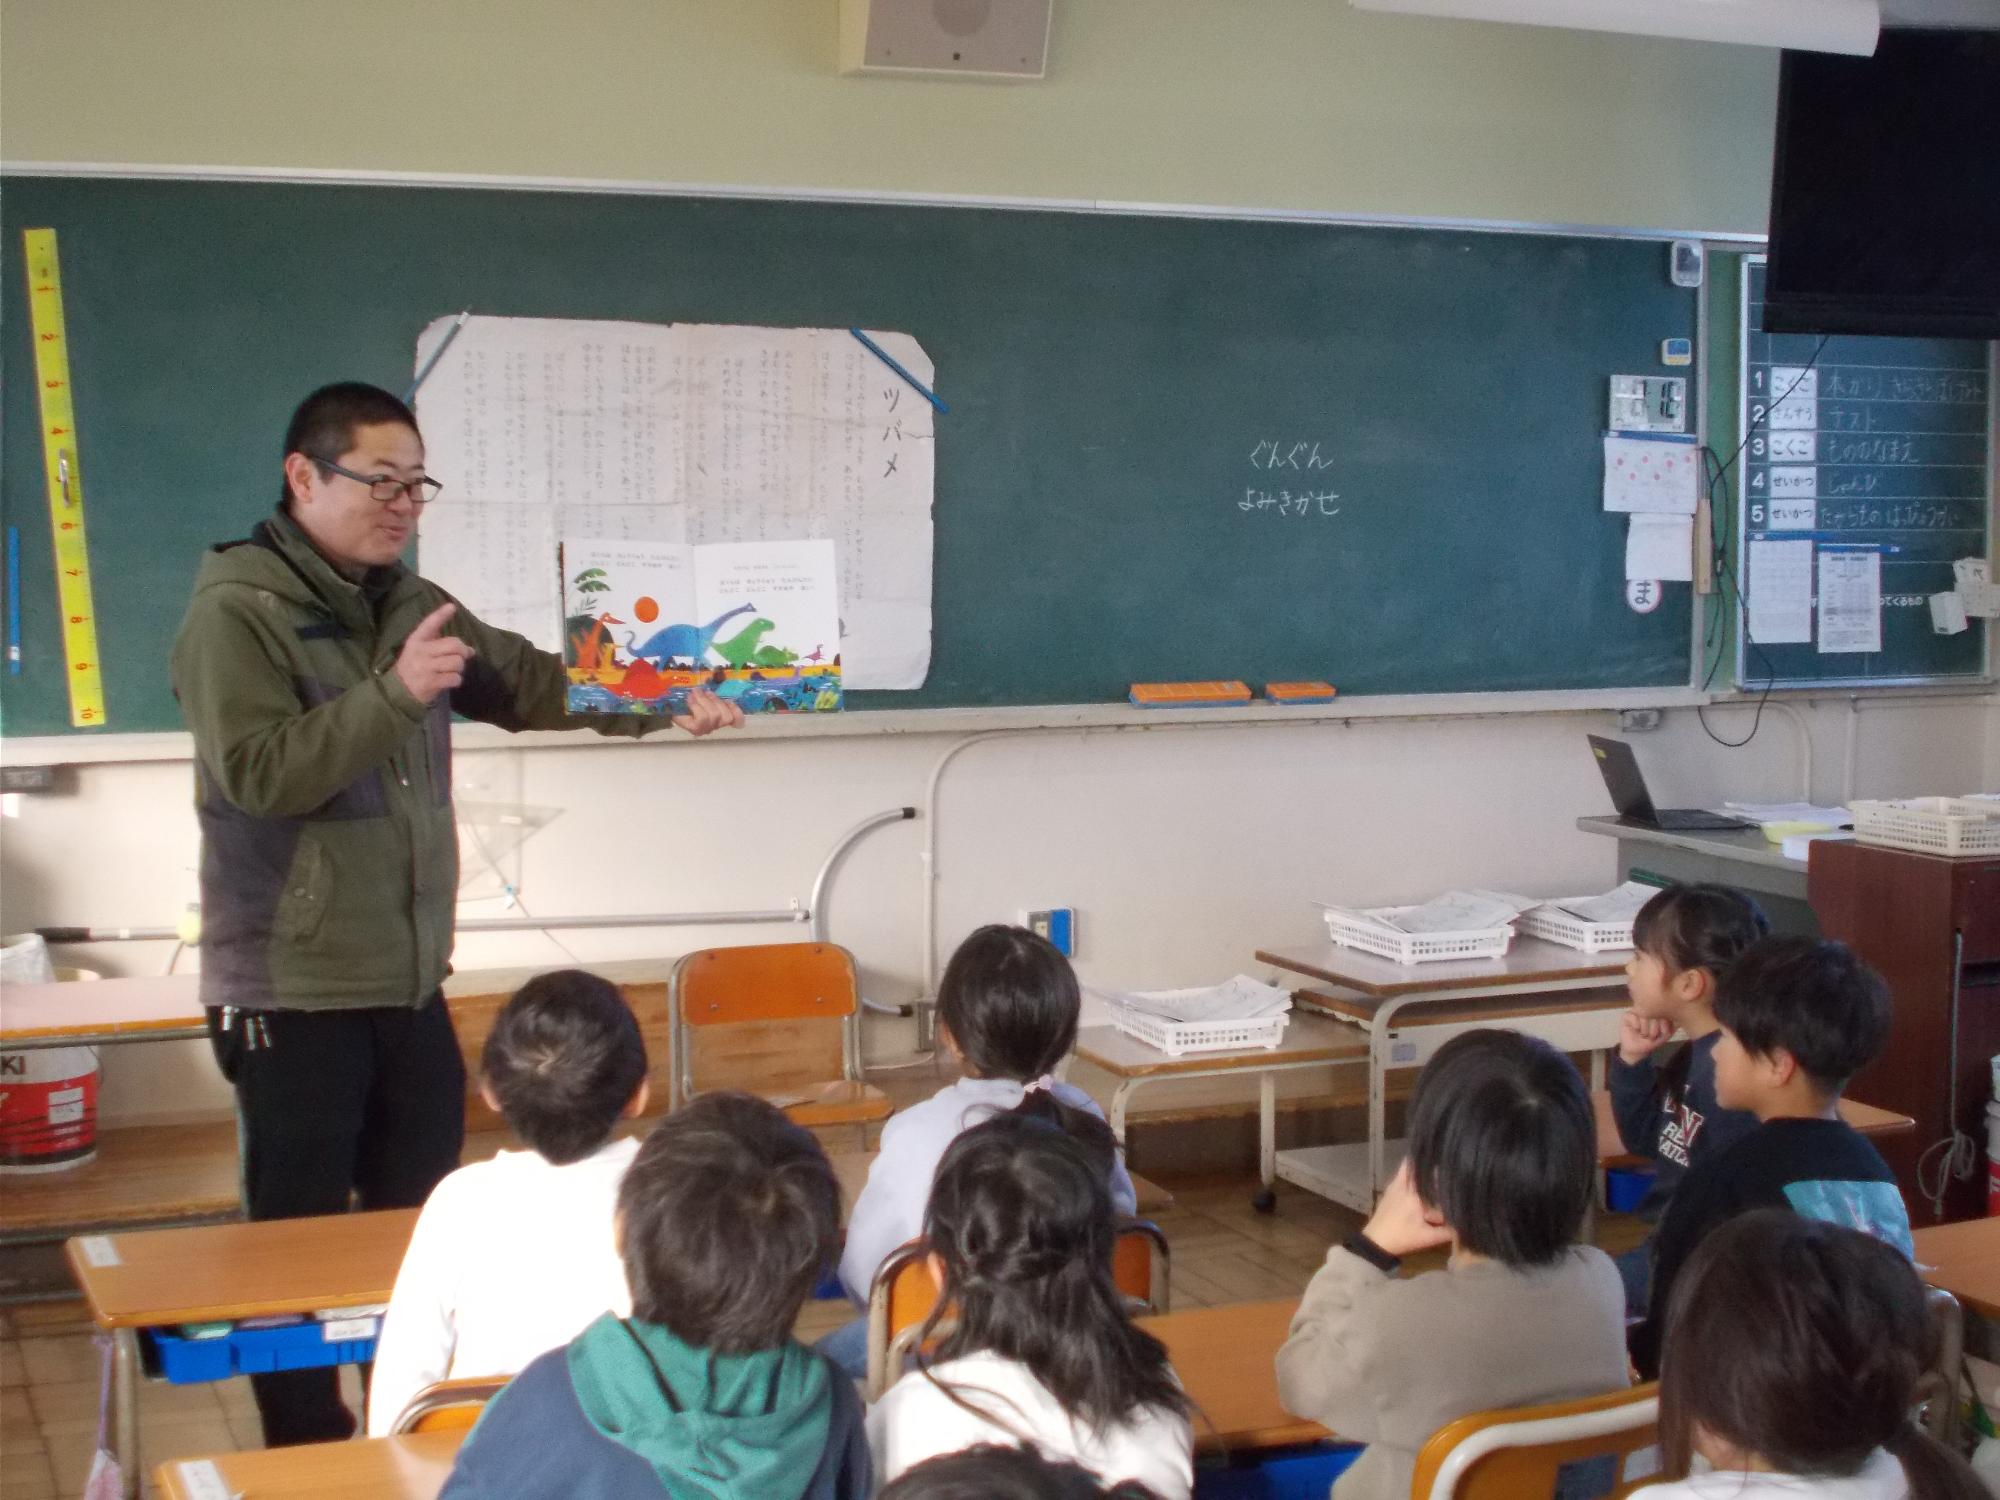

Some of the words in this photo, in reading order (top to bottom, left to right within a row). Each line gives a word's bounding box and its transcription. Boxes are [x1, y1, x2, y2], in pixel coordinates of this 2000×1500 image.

[1755, 370, 1762, 389] 1
[1753, 404, 1765, 422] 2
[882, 388, 902, 478] ツバメ
[1250, 440, 1334, 470] ぐんぐん
[1752, 438, 1764, 455] 3
[1773, 438, 1810, 455] こくご
[1752, 471, 1764, 488] 4
[1773, 476, 1815, 487] せいかつ
[1752, 504, 1764, 522] 5
[46, 380, 59, 388] 3
[80, 707, 92, 720] 10
